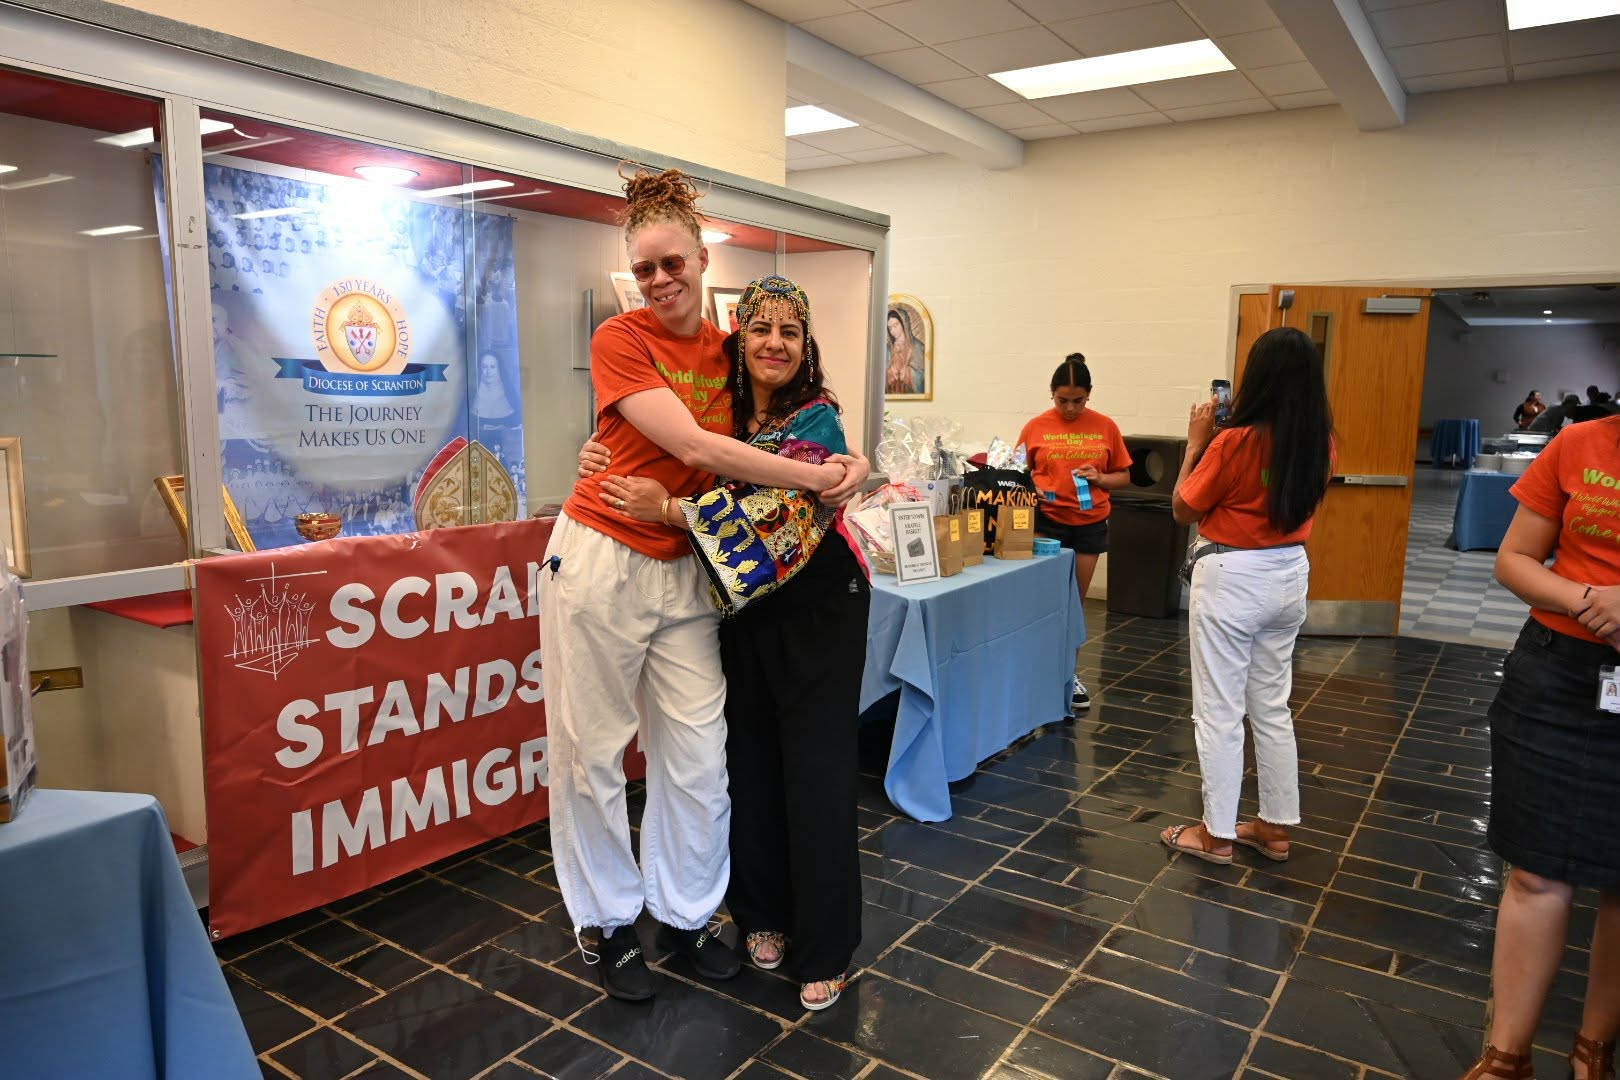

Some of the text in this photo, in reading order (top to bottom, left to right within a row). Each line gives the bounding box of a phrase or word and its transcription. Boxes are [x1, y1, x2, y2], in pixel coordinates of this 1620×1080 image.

[313, 279, 409, 359] FAITH 150 YEARS HOPE
[308, 376, 424, 391] DIOCESE OF SCRANTON
[304, 404, 423, 425] THE JOURNEY
[299, 428, 426, 447] MAKES US ONE
[1042, 433, 1104, 441] World Refugee
[976, 489, 1038, 507] MAKING
[1569, 515, 1613, 538] Come
[275, 649, 544, 770] STANDS
[292, 736, 549, 876] IMMIGR
